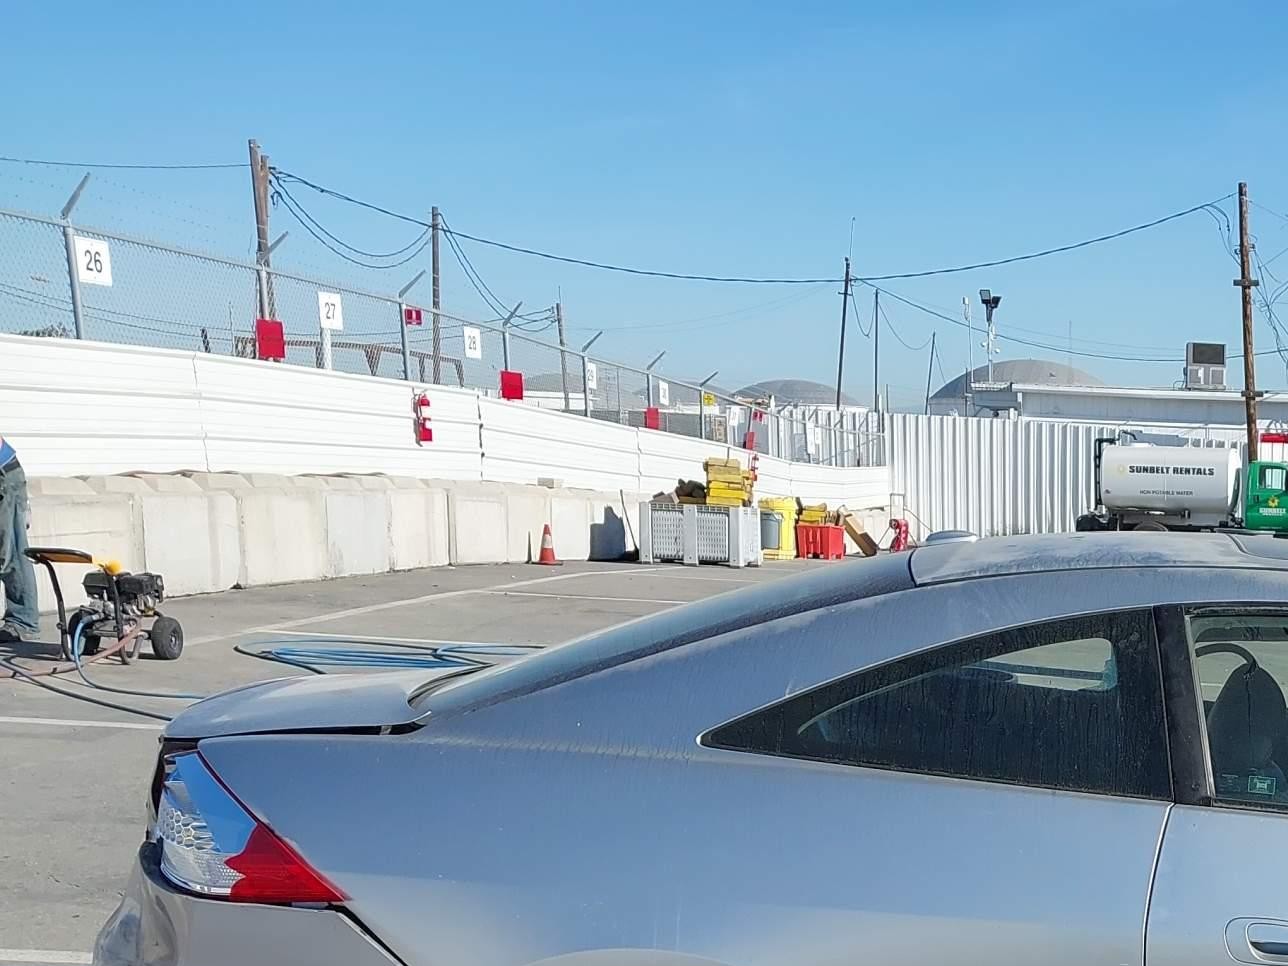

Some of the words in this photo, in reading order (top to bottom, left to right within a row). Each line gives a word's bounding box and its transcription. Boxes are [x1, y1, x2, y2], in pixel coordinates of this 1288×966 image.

[84, 249, 103, 273] 26
[324, 301, 336, 320] 27
[467, 335, 478, 351] 28
[1128, 465, 1171, 475] SUNBELT
[1172, 466, 1215, 476] RENTALS
